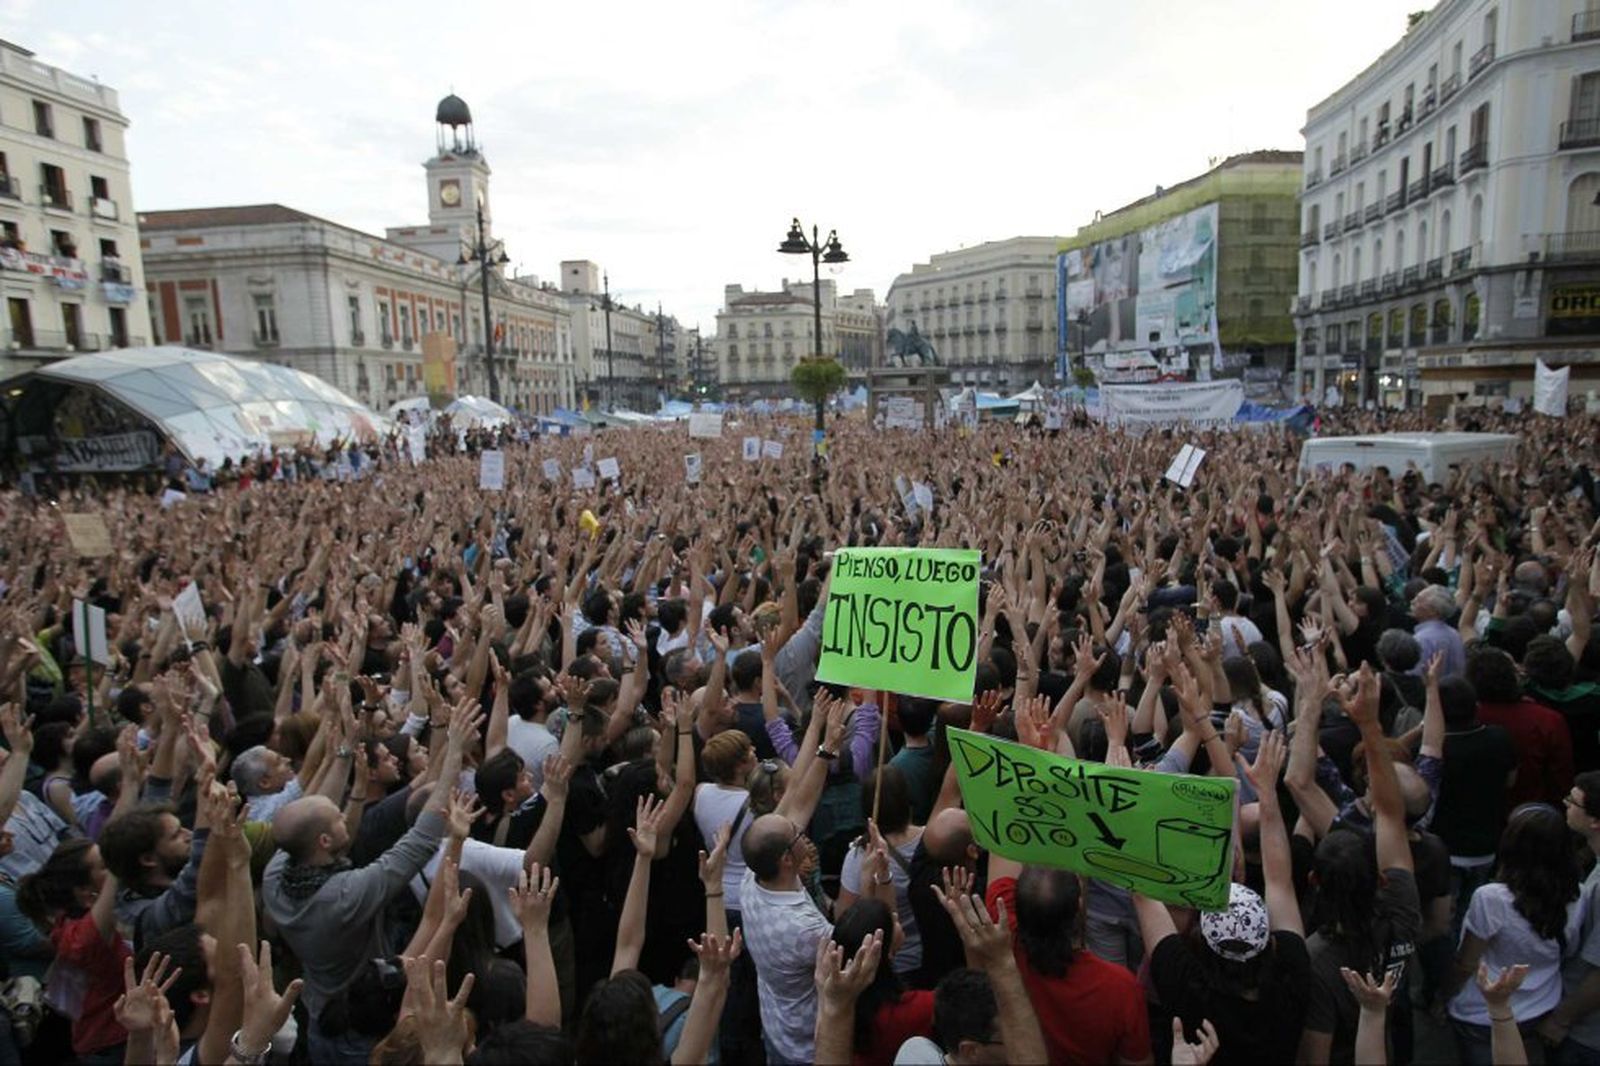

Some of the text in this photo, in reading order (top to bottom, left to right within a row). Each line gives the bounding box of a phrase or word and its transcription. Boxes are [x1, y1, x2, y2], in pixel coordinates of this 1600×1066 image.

[905, 557, 976, 583] LUEGO
[823, 592, 976, 672] INSISTO
[1013, 796, 1067, 820] SU
[971, 810, 1077, 847] VOTO
